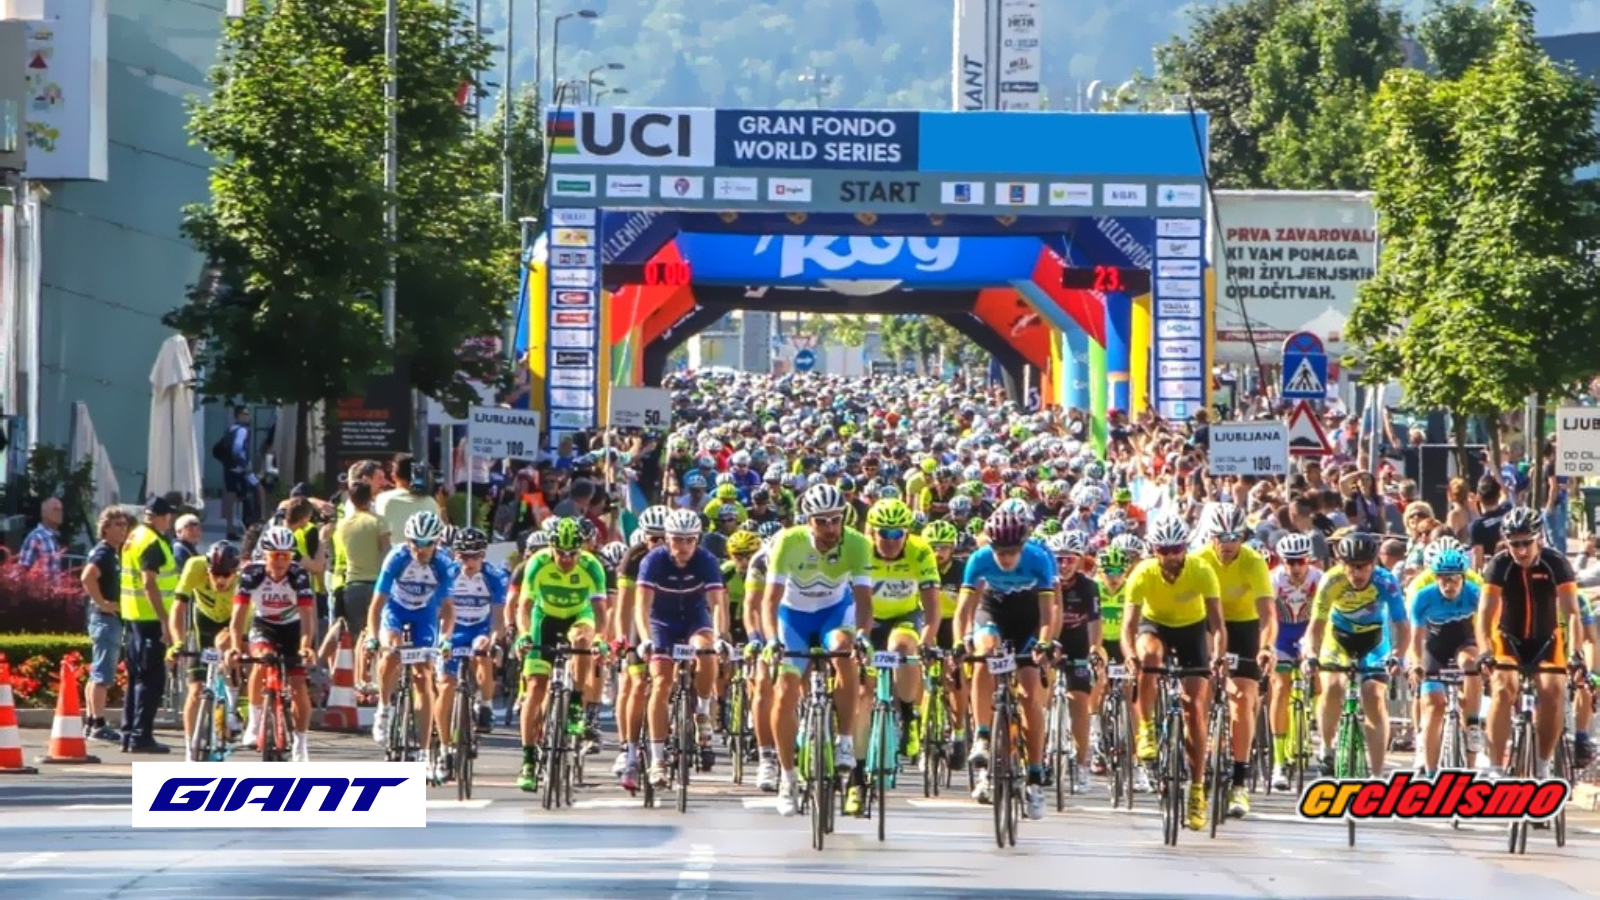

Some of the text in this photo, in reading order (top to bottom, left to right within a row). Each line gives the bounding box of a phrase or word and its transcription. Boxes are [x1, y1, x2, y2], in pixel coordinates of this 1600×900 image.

[581, 111, 692, 157] UCI
[738, 116, 896, 138] GRAN FONDO
[733, 140, 902, 163] WORLD SERIES
[840, 180, 921, 203] START
[1226, 228, 1375, 242] PRVA ZAVAROVAL
[1226, 247, 1359, 261] KI VAM POMAGA
[1226, 267, 1254, 280] PRI
[1226, 282, 1336, 299] ODLOČITVAH.
[474, 413, 535, 426] LJUBLJANA
[645, 409, 660, 426] 50
[1215, 432, 1281, 442] LJUBLJANA
[507, 441, 524, 457] 100
[1253, 456, 1271, 471] 100
[1565, 462, 1594, 471] TO GO
